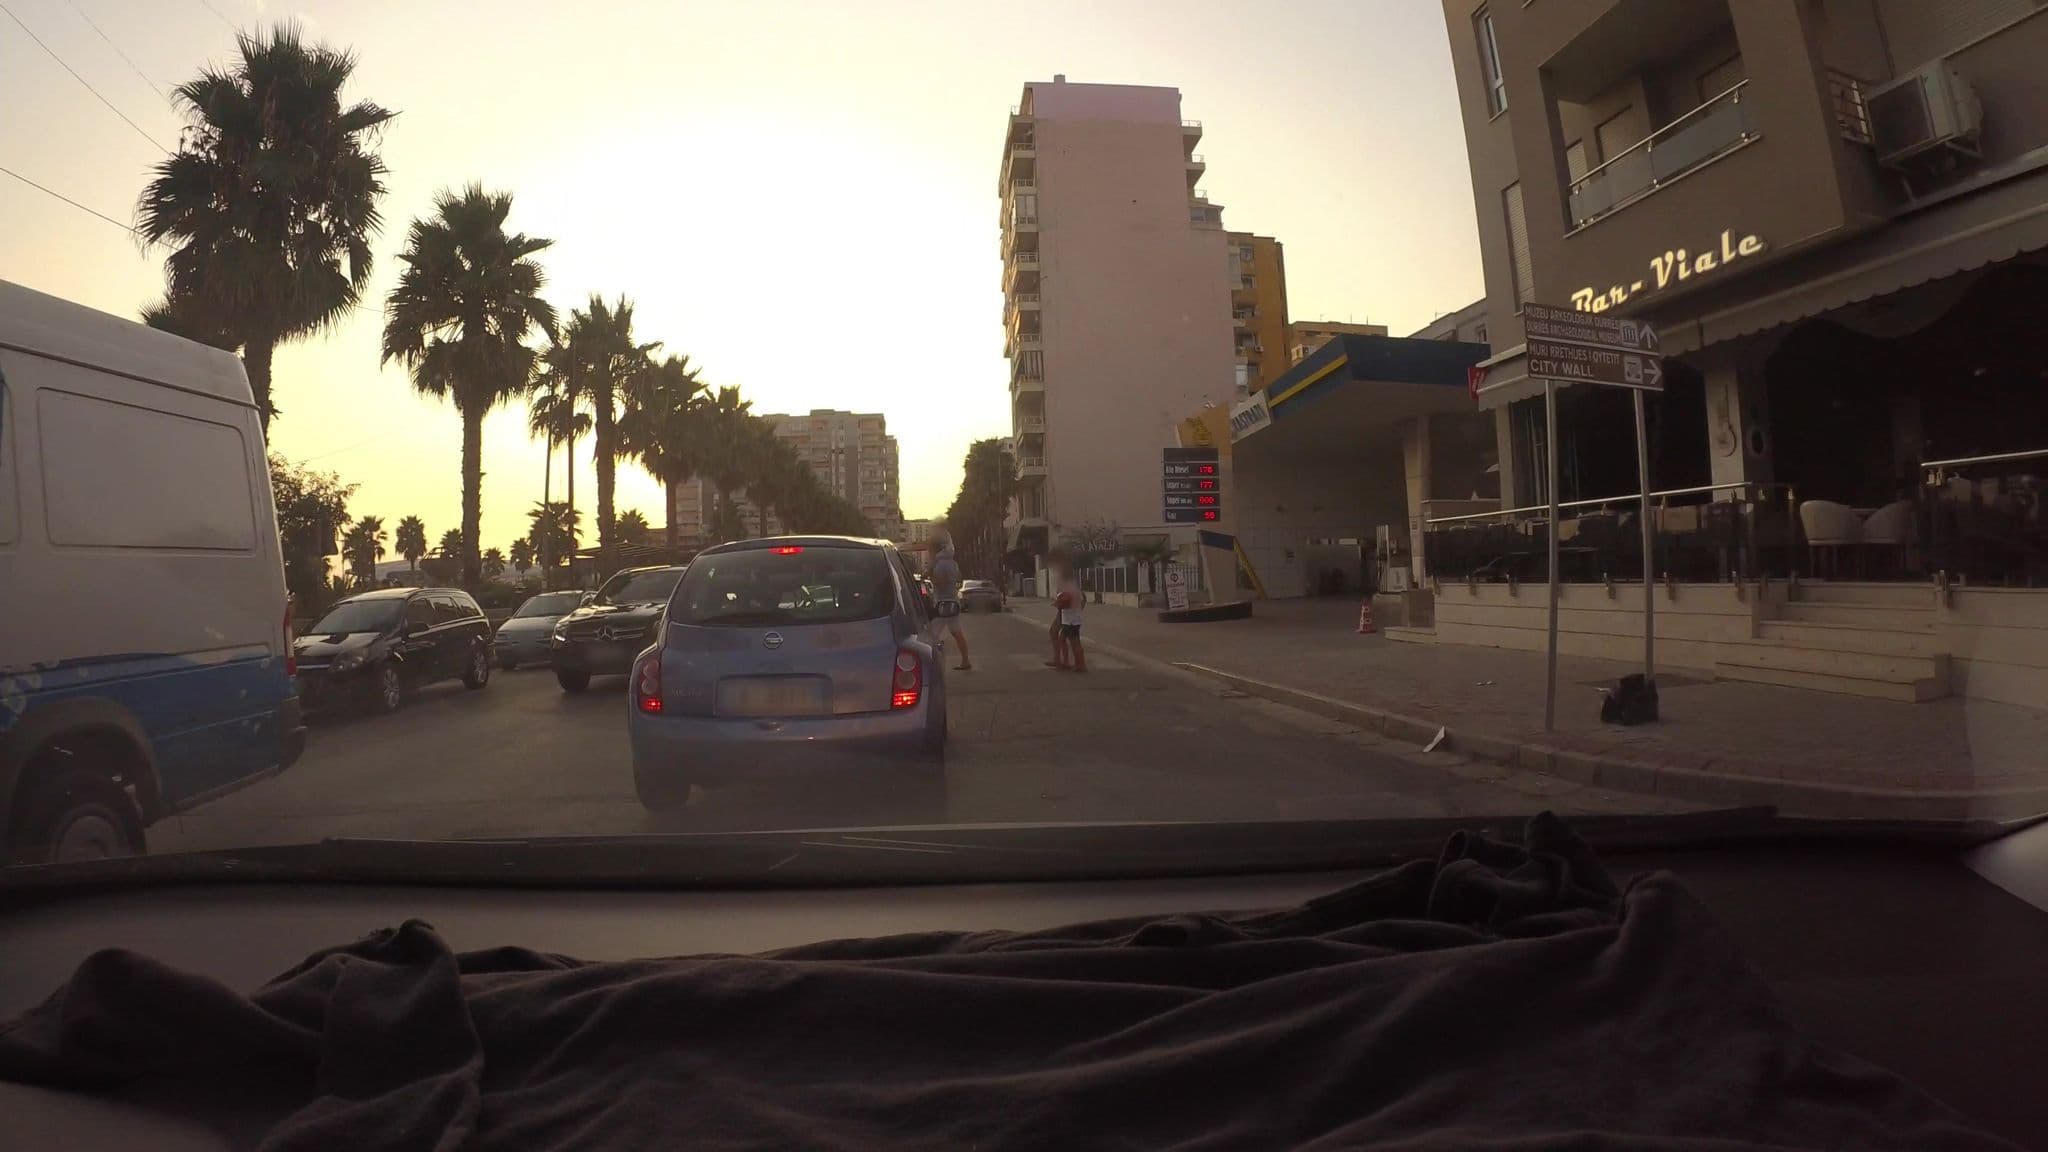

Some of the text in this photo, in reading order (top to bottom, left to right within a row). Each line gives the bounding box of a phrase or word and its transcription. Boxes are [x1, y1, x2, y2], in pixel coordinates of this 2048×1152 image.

[1650, 228, 1767, 290] Viale
[1529, 343, 1549, 356] MURI
[1530, 360, 1595, 378] CITY WALL
